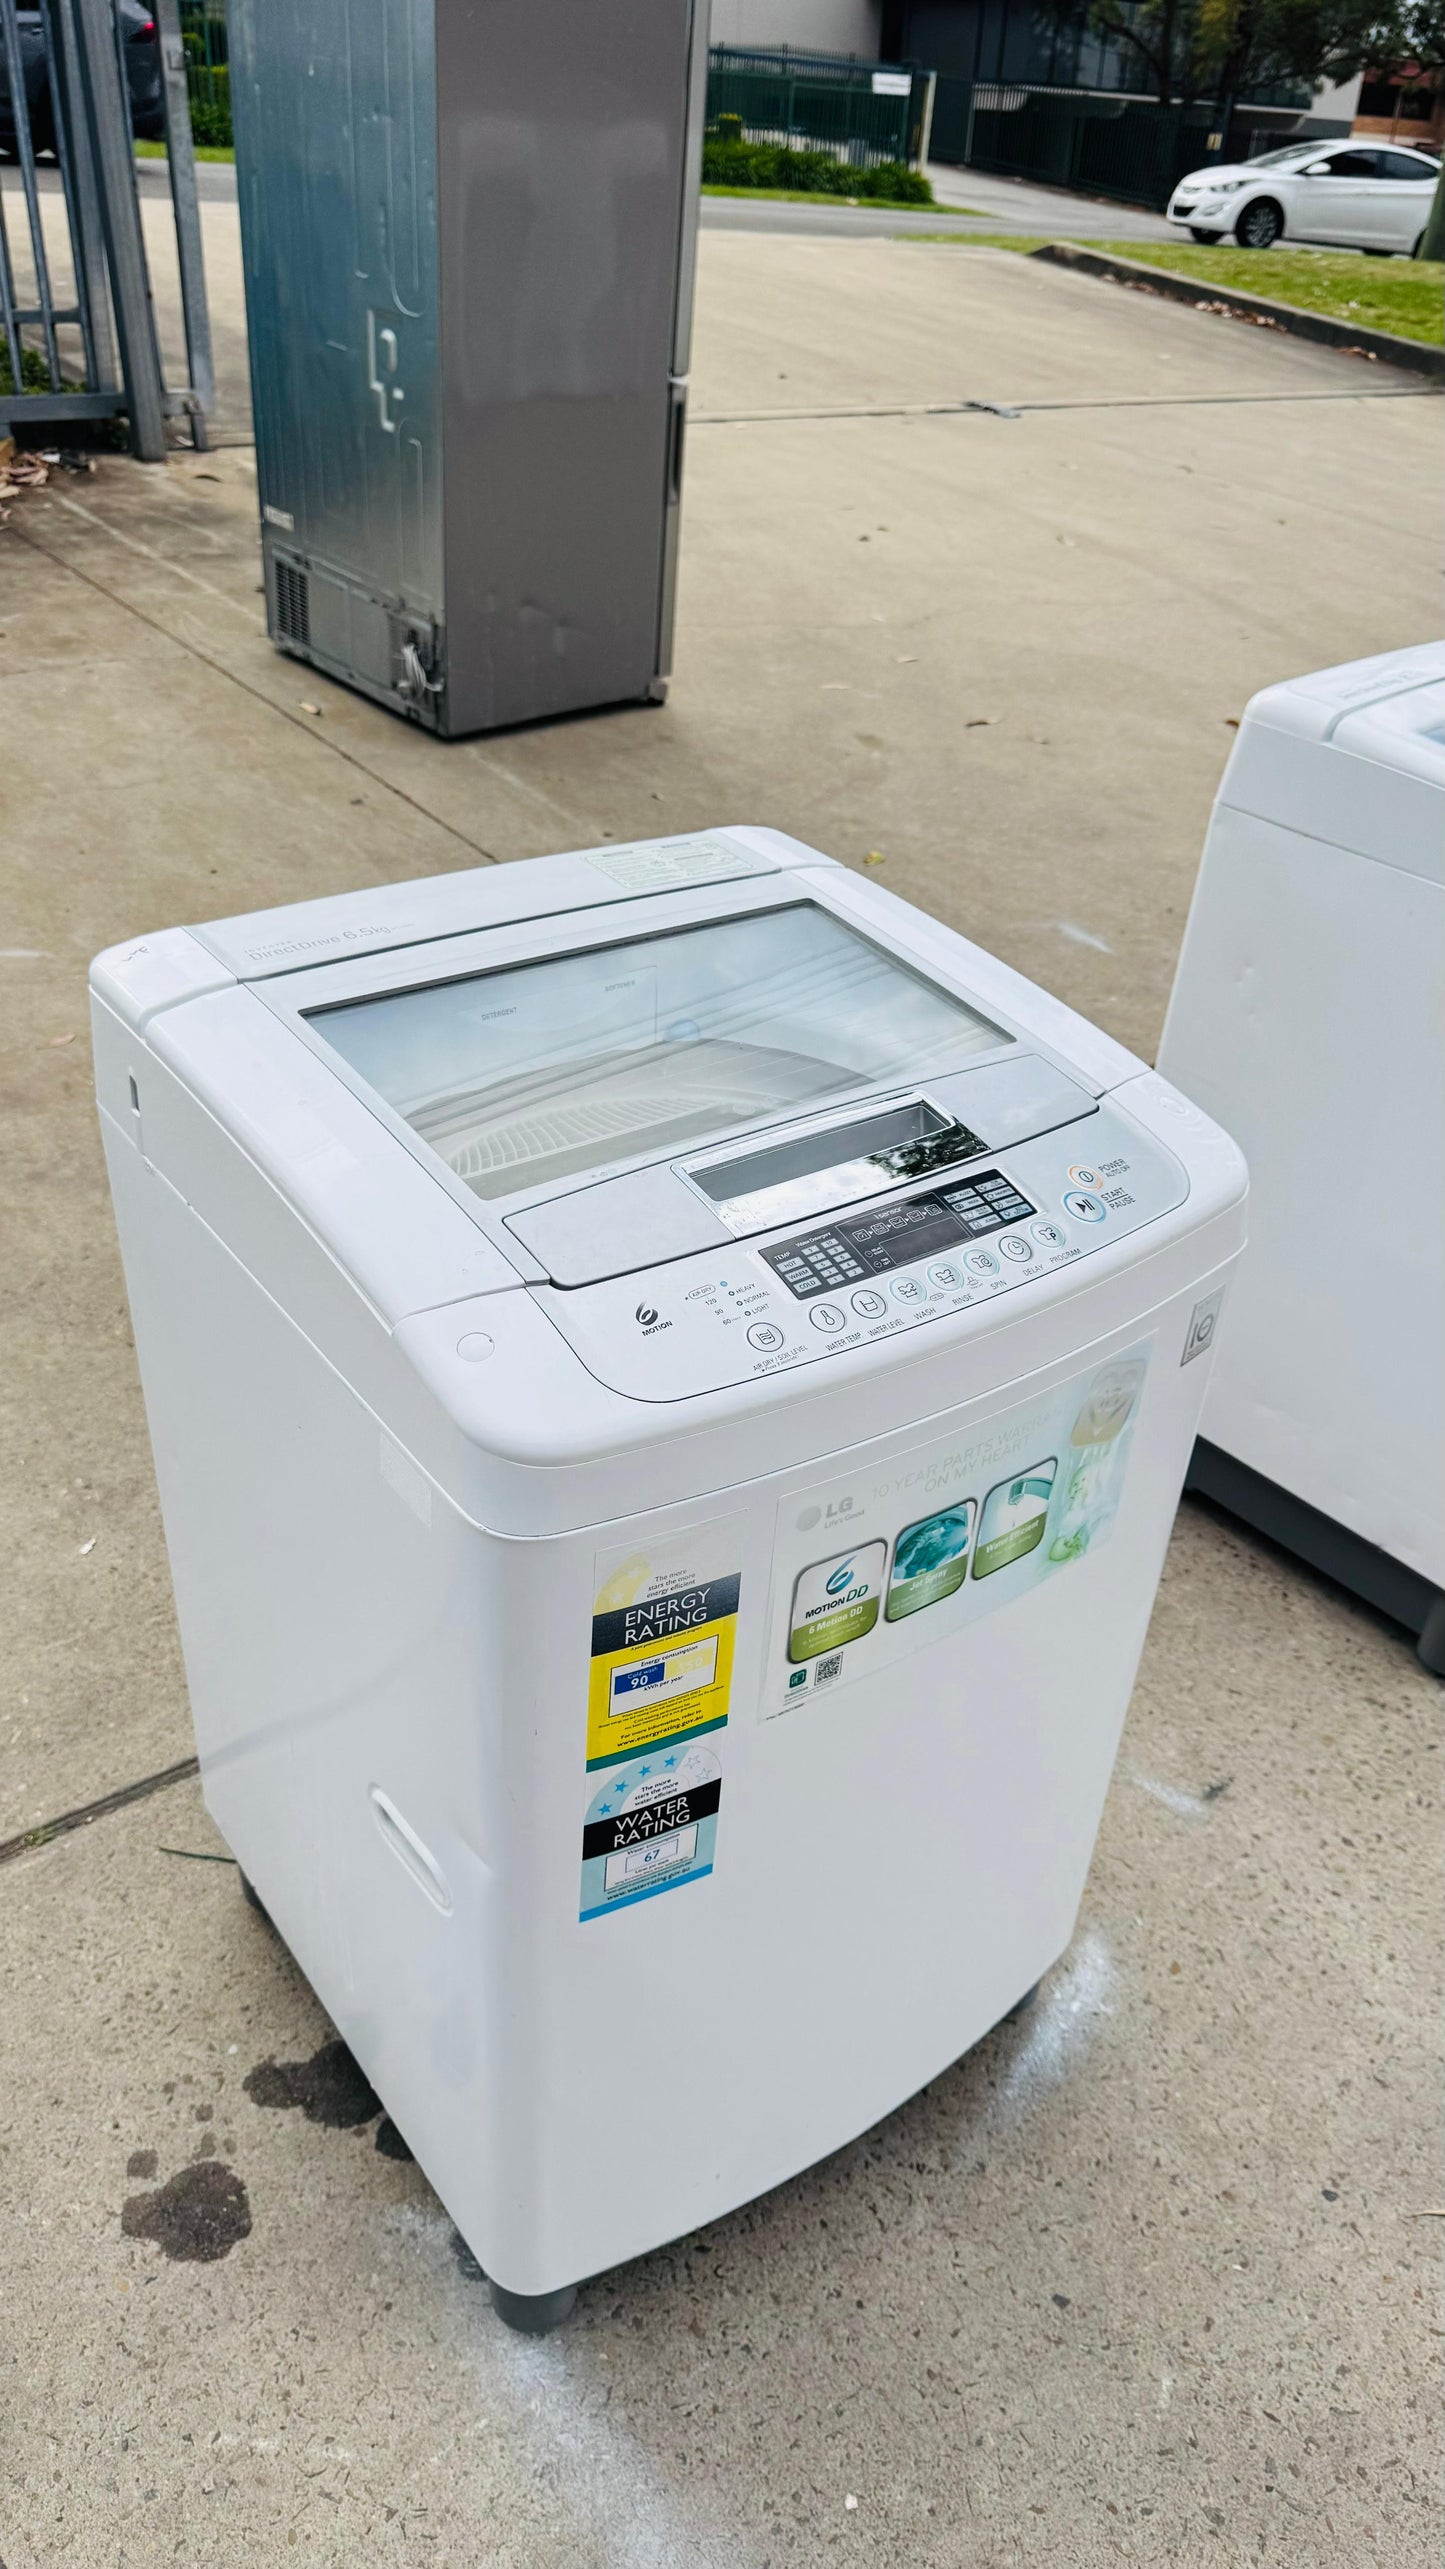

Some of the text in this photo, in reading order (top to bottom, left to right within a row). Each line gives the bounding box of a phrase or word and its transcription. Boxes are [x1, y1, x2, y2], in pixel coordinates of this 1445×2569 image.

[343, 925, 391, 941] 6.5kg
[481, 1006, 517, 1021] DETERGENT
[1098, 1158, 1126, 1172] POWER
[1101, 1187, 1125, 1202] START
[1109, 1195, 1136, 1210] PAUSE
[1050, 1248, 1082, 1264] PROGRAM
[784, 1261, 796, 1269] HOT
[1022, 1264, 1044, 1276] DELAY
[789, 1269, 810, 1280] WARM
[735, 1283, 756, 1294] HEAVY
[800, 1280, 816, 1290] COLD
[990, 1279, 1008, 1290] SPIN
[705, 1297, 717, 1306] 120
[743, 1290, 771, 1304] NORMAL
[951, 1293, 974, 1306] RINSE
[714, 1308, 724, 1316] 90
[752, 1303, 770, 1315] LIGHT
[913, 1307, 937, 1320] WASH
[641, 1320, 673, 1337] MOTION
[867, 1318, 905, 1337] WATER LEVEL
[825, 1338, 846, 1351] WATER
[753, 1362, 763, 1372] AIR
[763, 1358, 775, 1368] DRY
[778, 1350, 791, 1361] SOIL
[791, 1345, 808, 1356] LEVEL
[872, 1483, 890, 1501] 10
[894, 1463, 938, 1492] YEAR
[943, 1438, 993, 1471] PARTS
[923, 1435, 1032, 1493] ON MY HEART
[825, 1496, 854, 1519] LG
[844, 1508, 865, 1521] Good
[986, 1540, 1008, 1553] Water
[648, 1572, 696, 1592] stars the more
[655, 1569, 688, 1582] The more
[909, 1569, 947, 1591] Jet Spray
[646, 1579, 696, 1599] energy efficient
[625, 1587, 711, 1627] ENERGY
[805, 1596, 845, 1619] MOTION
[846, 1583, 869, 1602] DD
[625, 1606, 708, 1645] RATING
[808, 1605, 863, 1635] 6 Motion DD
[640, 1645, 699, 1667] Energy consumption
[627, 1666, 659, 1680] Cold wash
[630, 1675, 649, 1689] 90
[659, 1680, 670, 1688] per
[670, 1674, 684, 1685] year
[617, 1715, 704, 1747] www.energyrating.gov.au
[631, 1728, 647, 1737] more
[681, 1712, 695, 1720] refer
[634, 1781, 679, 1801] stars the more
[641, 1779, 672, 1793] The more
[634, 1787, 678, 1806] water efficient
[615, 1796, 689, 1832] WATER
[613, 1809, 690, 1848] RATING
[644, 1849, 660, 1863] 67
